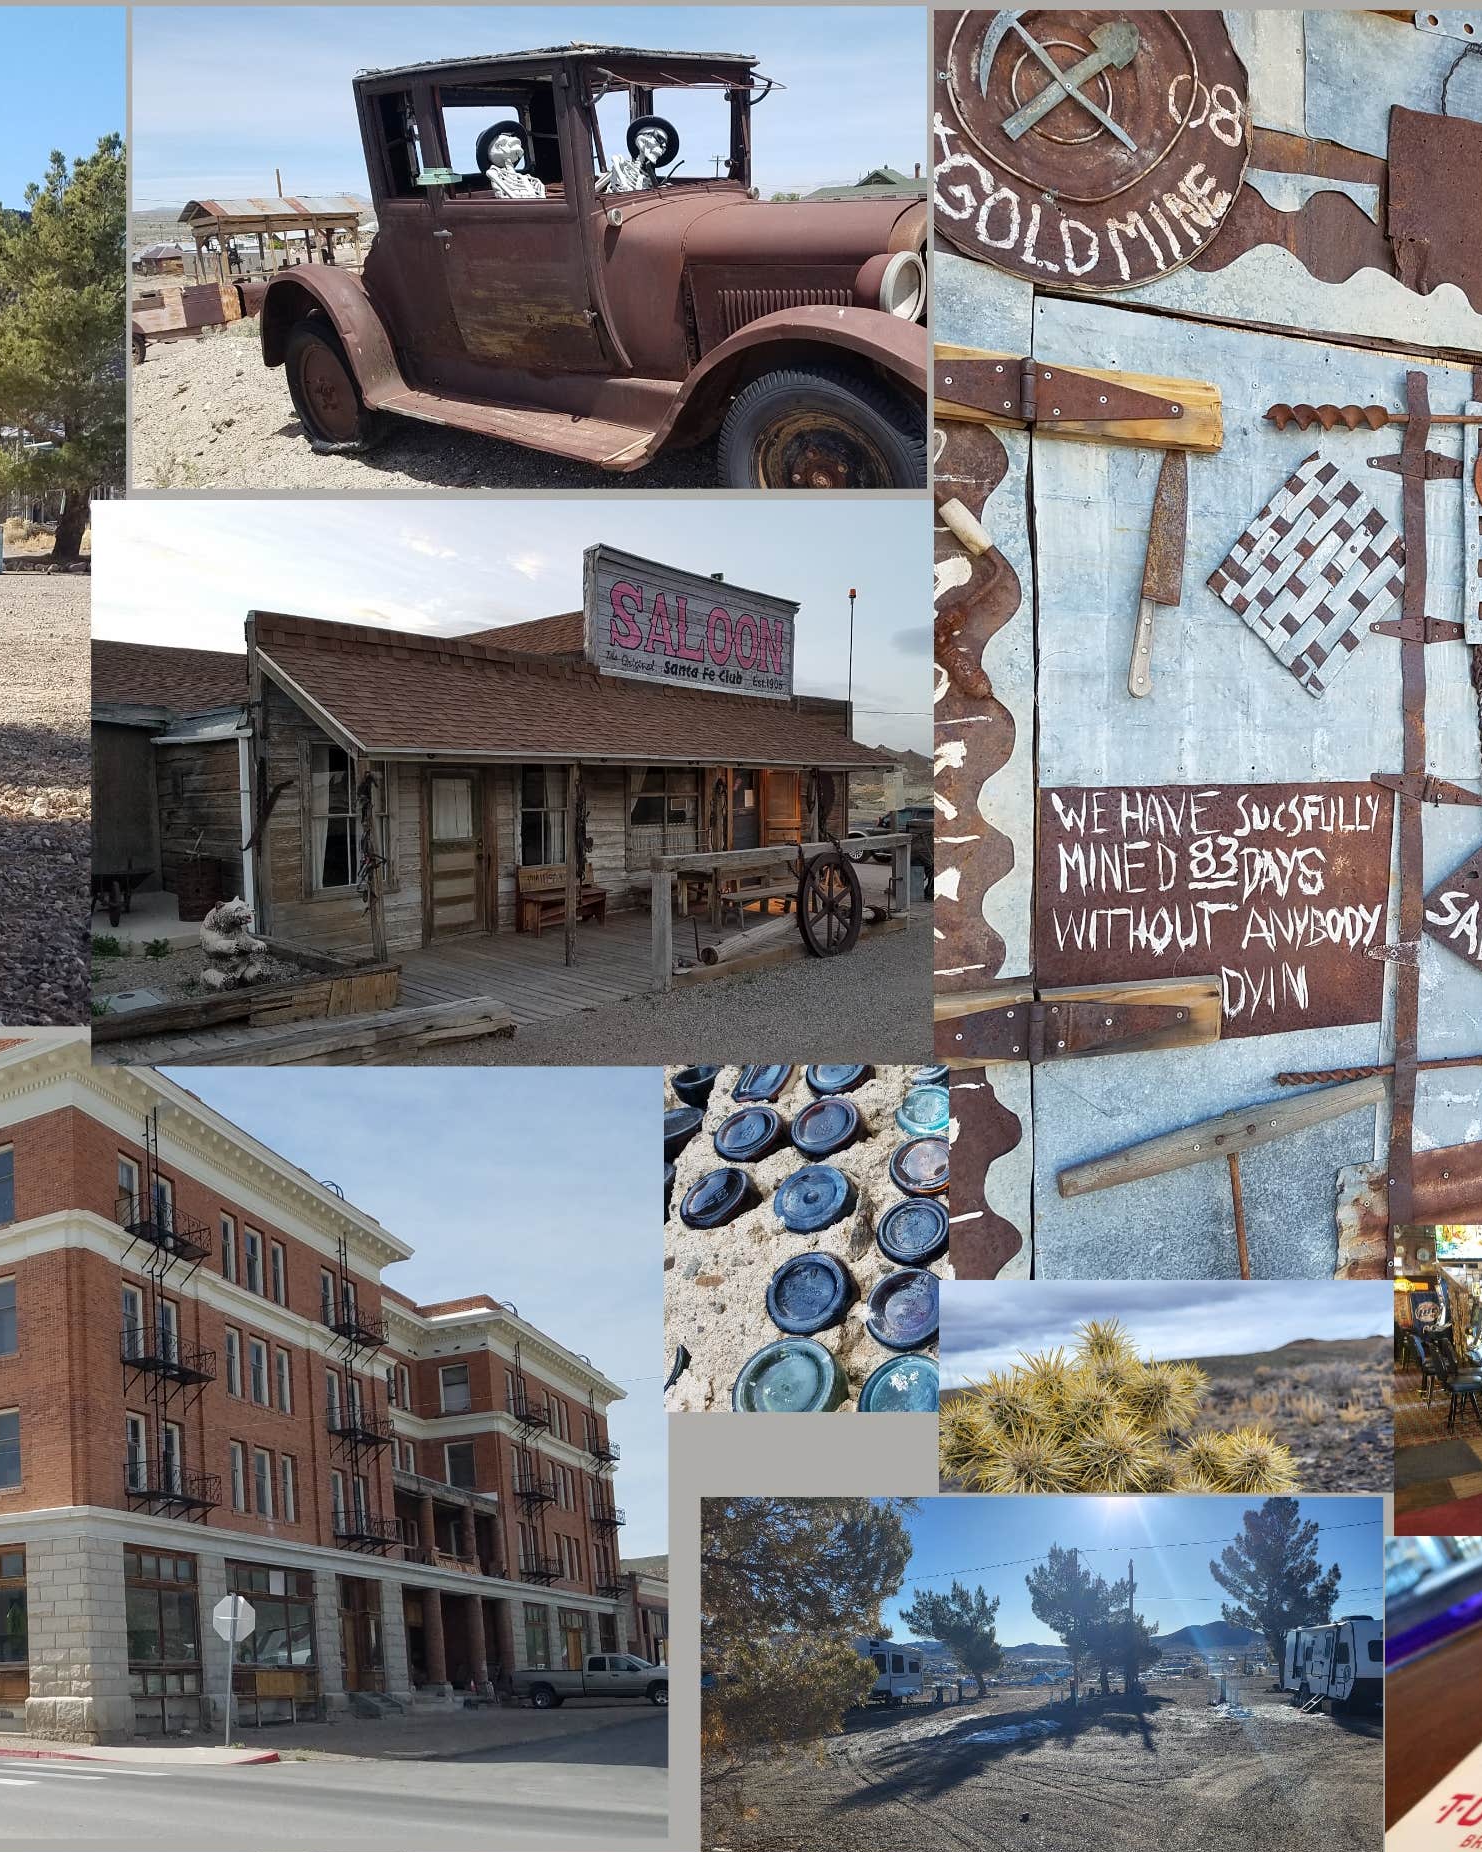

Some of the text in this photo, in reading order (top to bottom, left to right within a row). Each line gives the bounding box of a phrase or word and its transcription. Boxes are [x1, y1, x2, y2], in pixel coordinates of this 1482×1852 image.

[610, 581, 783, 675] SALOON
[664, 661, 698, 678] Santa
[702, 667, 715, 681] Fe
[719, 670, 742, 684] Club
[1053, 790, 1380, 836] WE HAVE SUCSFULLY
[1057, 837, 1326, 900] MINED 83 DAYS
[1053, 902, 1382, 956] WITHOUT ANYBODY
[1221, 966, 1309, 1019] DYIN
